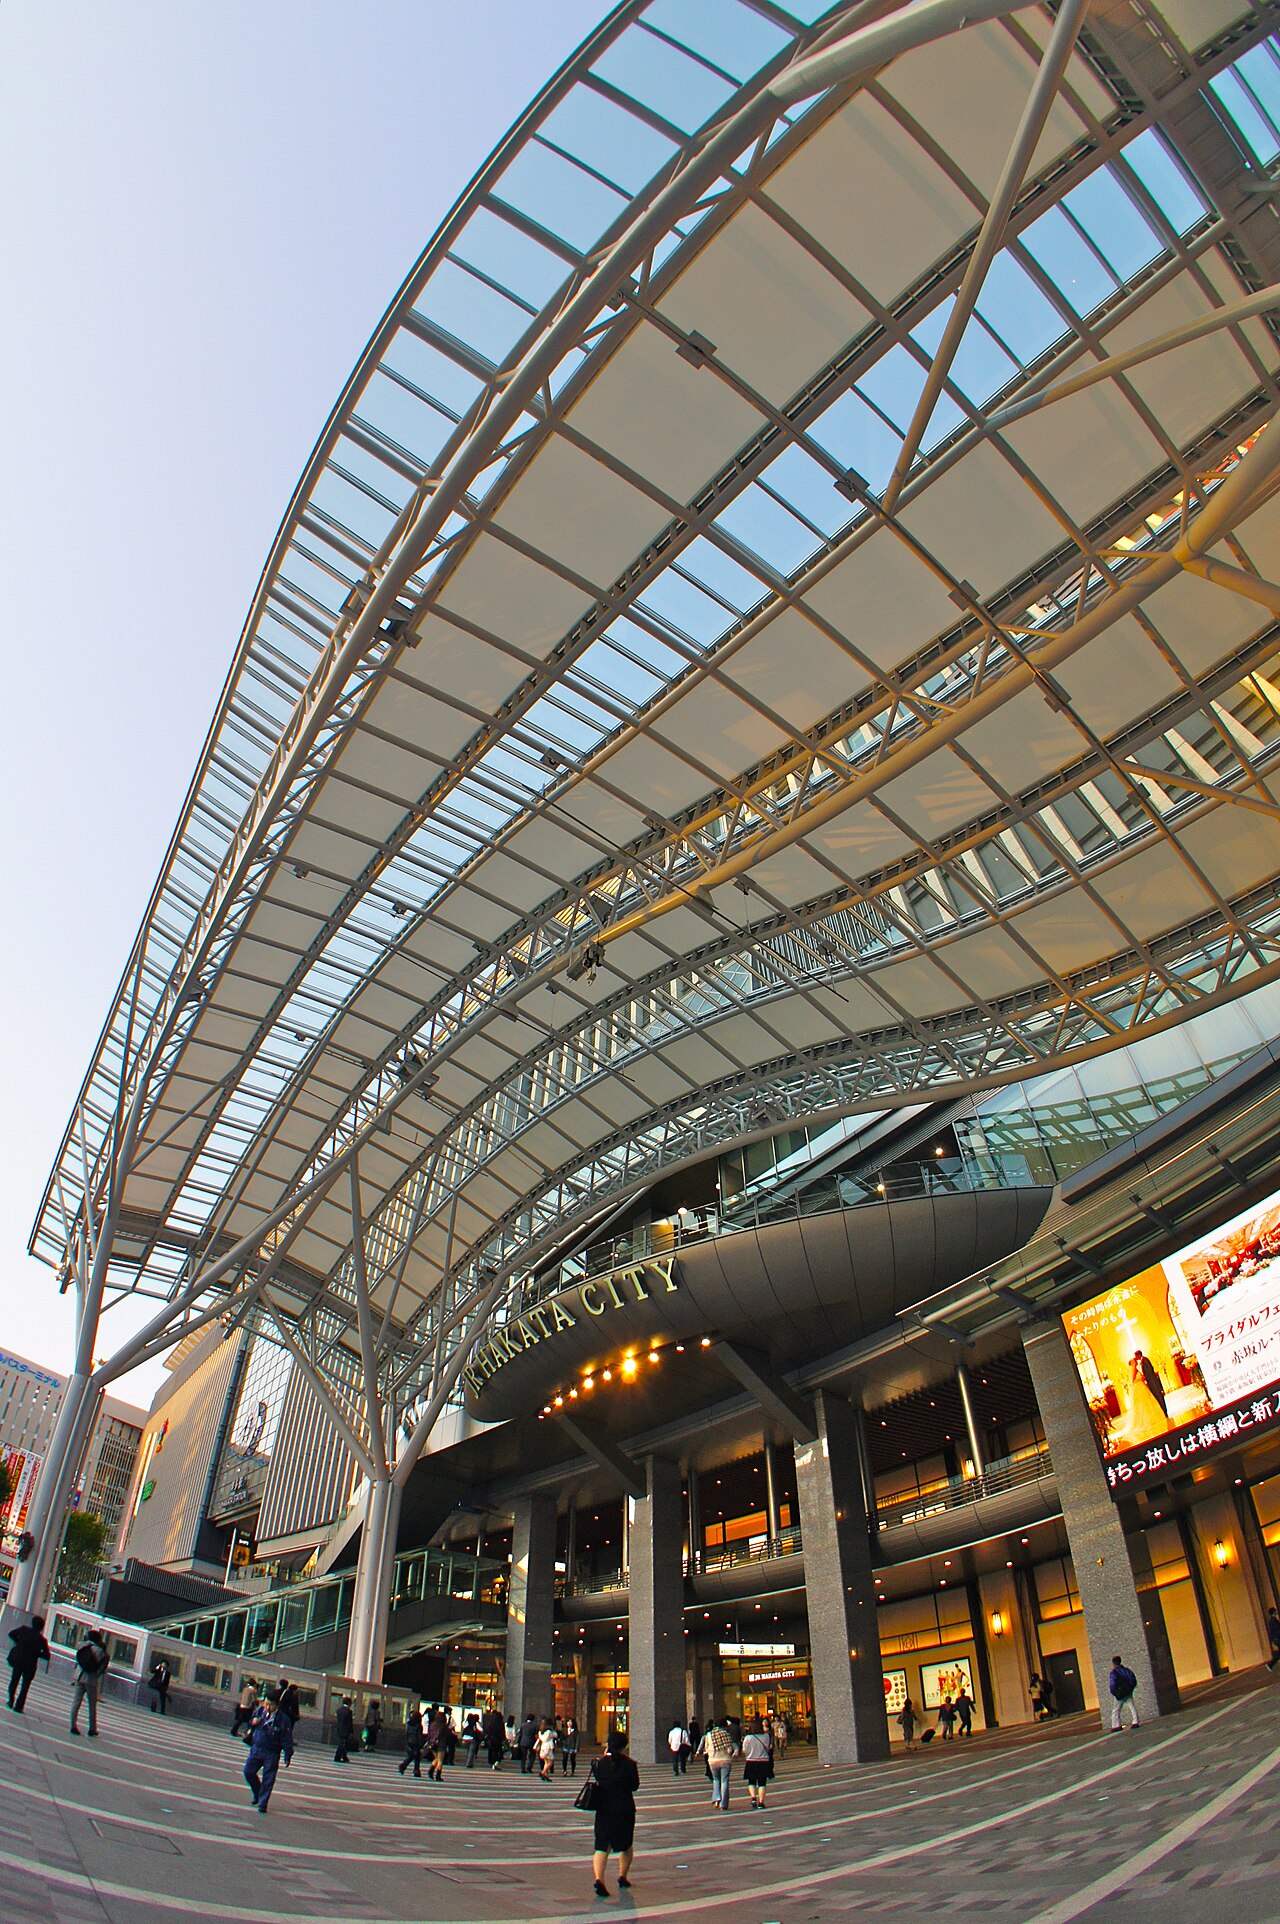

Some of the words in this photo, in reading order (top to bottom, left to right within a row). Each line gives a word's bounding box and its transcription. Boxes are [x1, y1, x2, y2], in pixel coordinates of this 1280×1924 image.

[462, 1365, 484, 1399] JR
[475, 1300, 577, 1379] HAKATA
[580, 1257, 678, 1316] CITY
[782, 1670, 795, 1678] CITY
